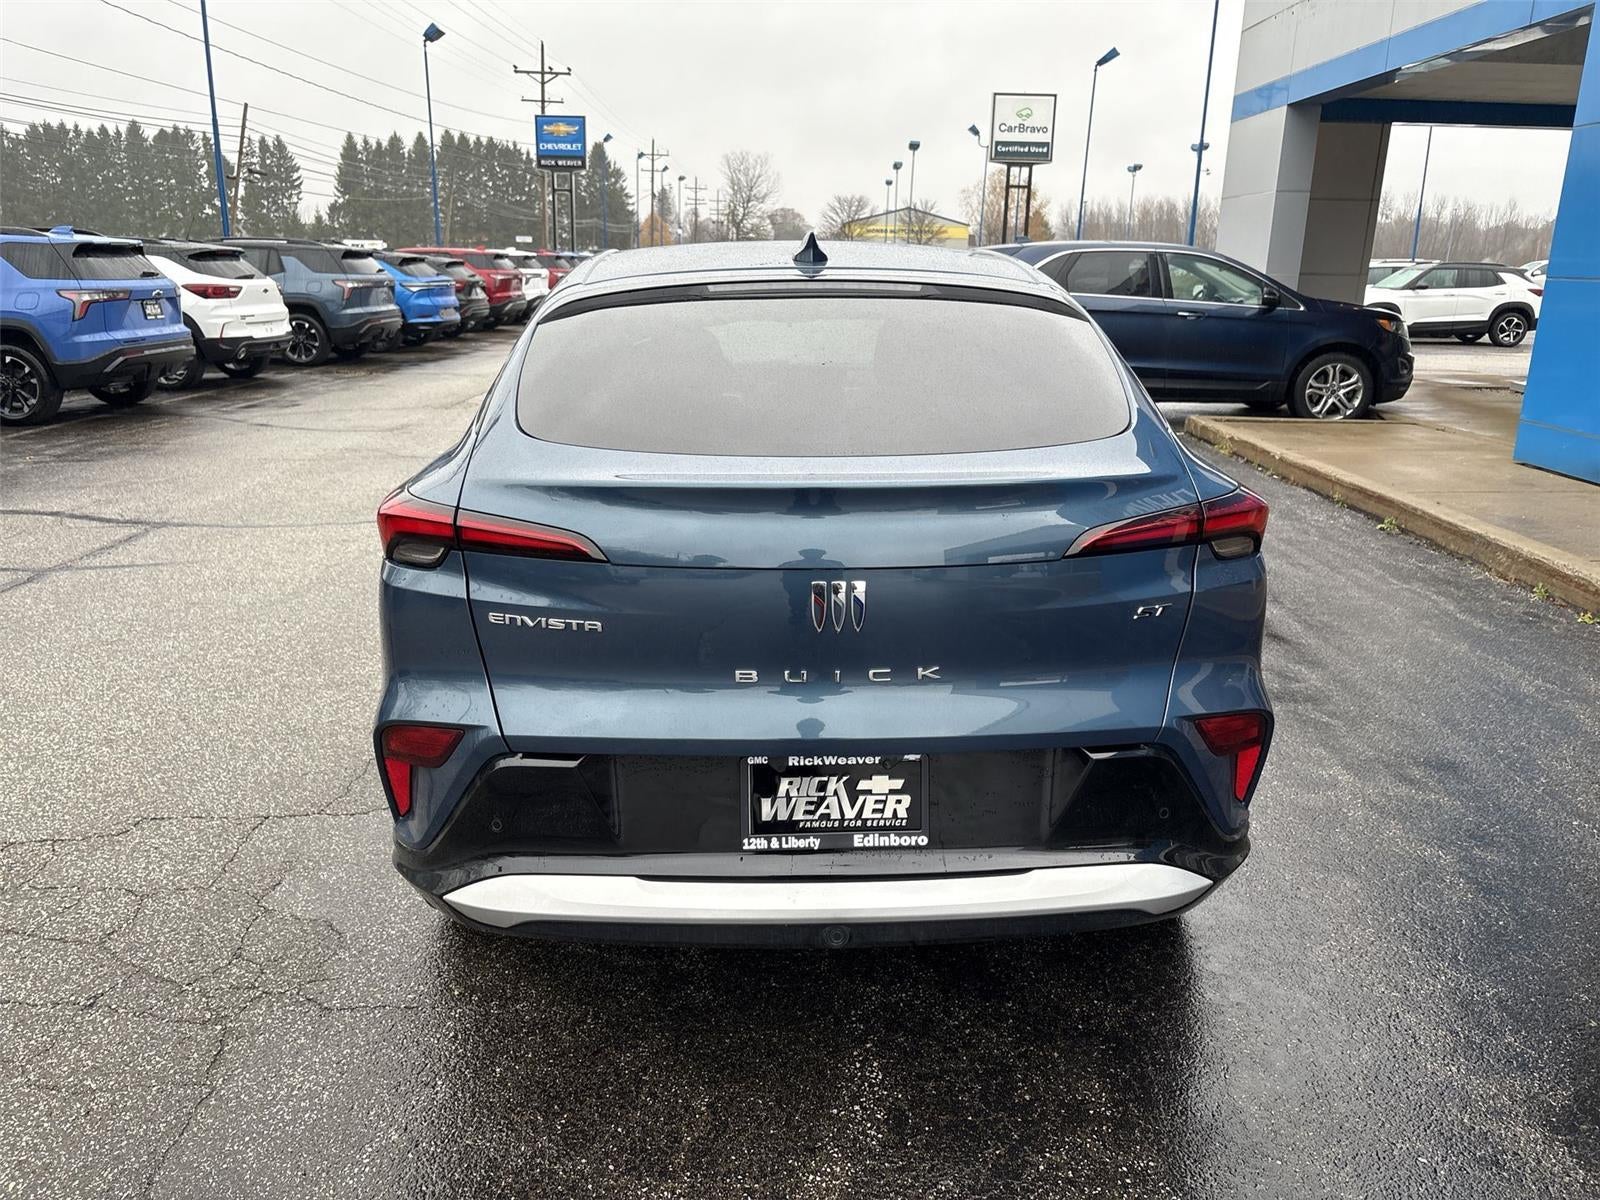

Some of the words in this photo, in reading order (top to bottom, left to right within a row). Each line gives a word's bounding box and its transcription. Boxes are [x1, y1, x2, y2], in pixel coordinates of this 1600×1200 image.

[998, 122, 1048, 133] CarBravo
[997, 145, 1029, 153] Certified
[1133, 603, 1172, 619] ST
[488, 612, 603, 632] ENVISTA
[735, 666, 942, 683] BUICK
[747, 756, 768, 765] GMC
[788, 755, 881, 767] RickWeaver
[777, 775, 850, 798] RICK
[761, 794, 911, 821] WEAVER
[800, 820, 839, 828] FAMOUS
[843, 820, 862, 828] FOR
[866, 819, 907, 827] SERVICE
[742, 837, 768, 850] 12th
[770, 838, 779, 849] &
[781, 836, 821, 850] Liberty
[853, 833, 928, 847] Edinboro
